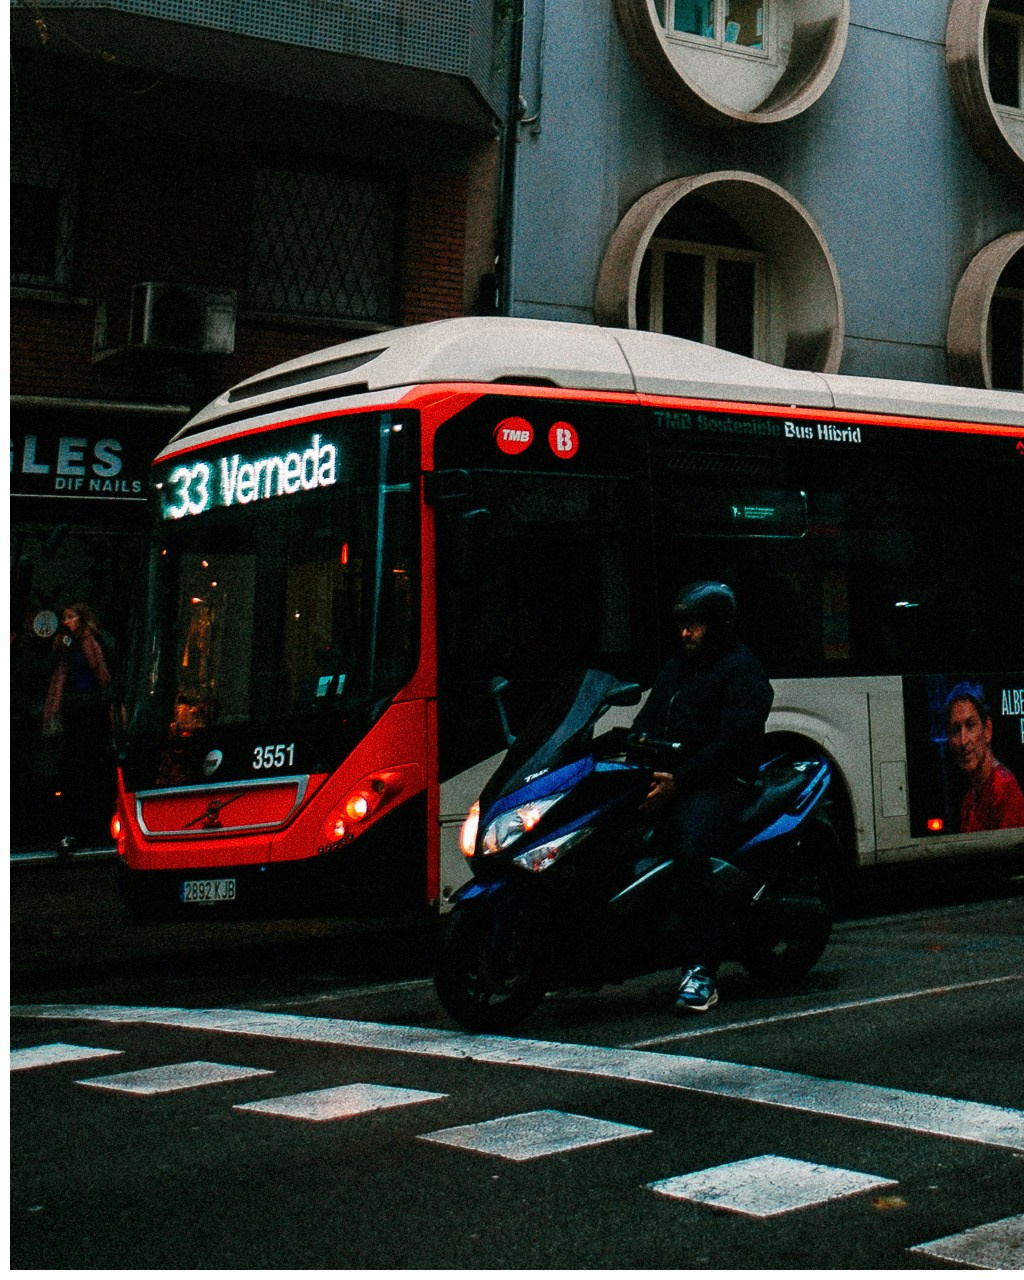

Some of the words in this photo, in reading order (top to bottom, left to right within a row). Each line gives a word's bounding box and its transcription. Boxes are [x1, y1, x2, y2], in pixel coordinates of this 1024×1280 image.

[502, 428, 530, 442] TMB
[556, 428, 573, 451] B
[784, 421, 813, 439] Bus
[10, 435, 122, 477] LES
[55, 477, 84, 490] DIF
[89, 478, 142, 493] NAILS
[167, 462, 211, 520] 33
[220, 433, 337, 507] Verneda
[252, 743, 295, 770] 3551
[186, 882, 212, 900] 2892
[214, 880, 235, 899] KJB
